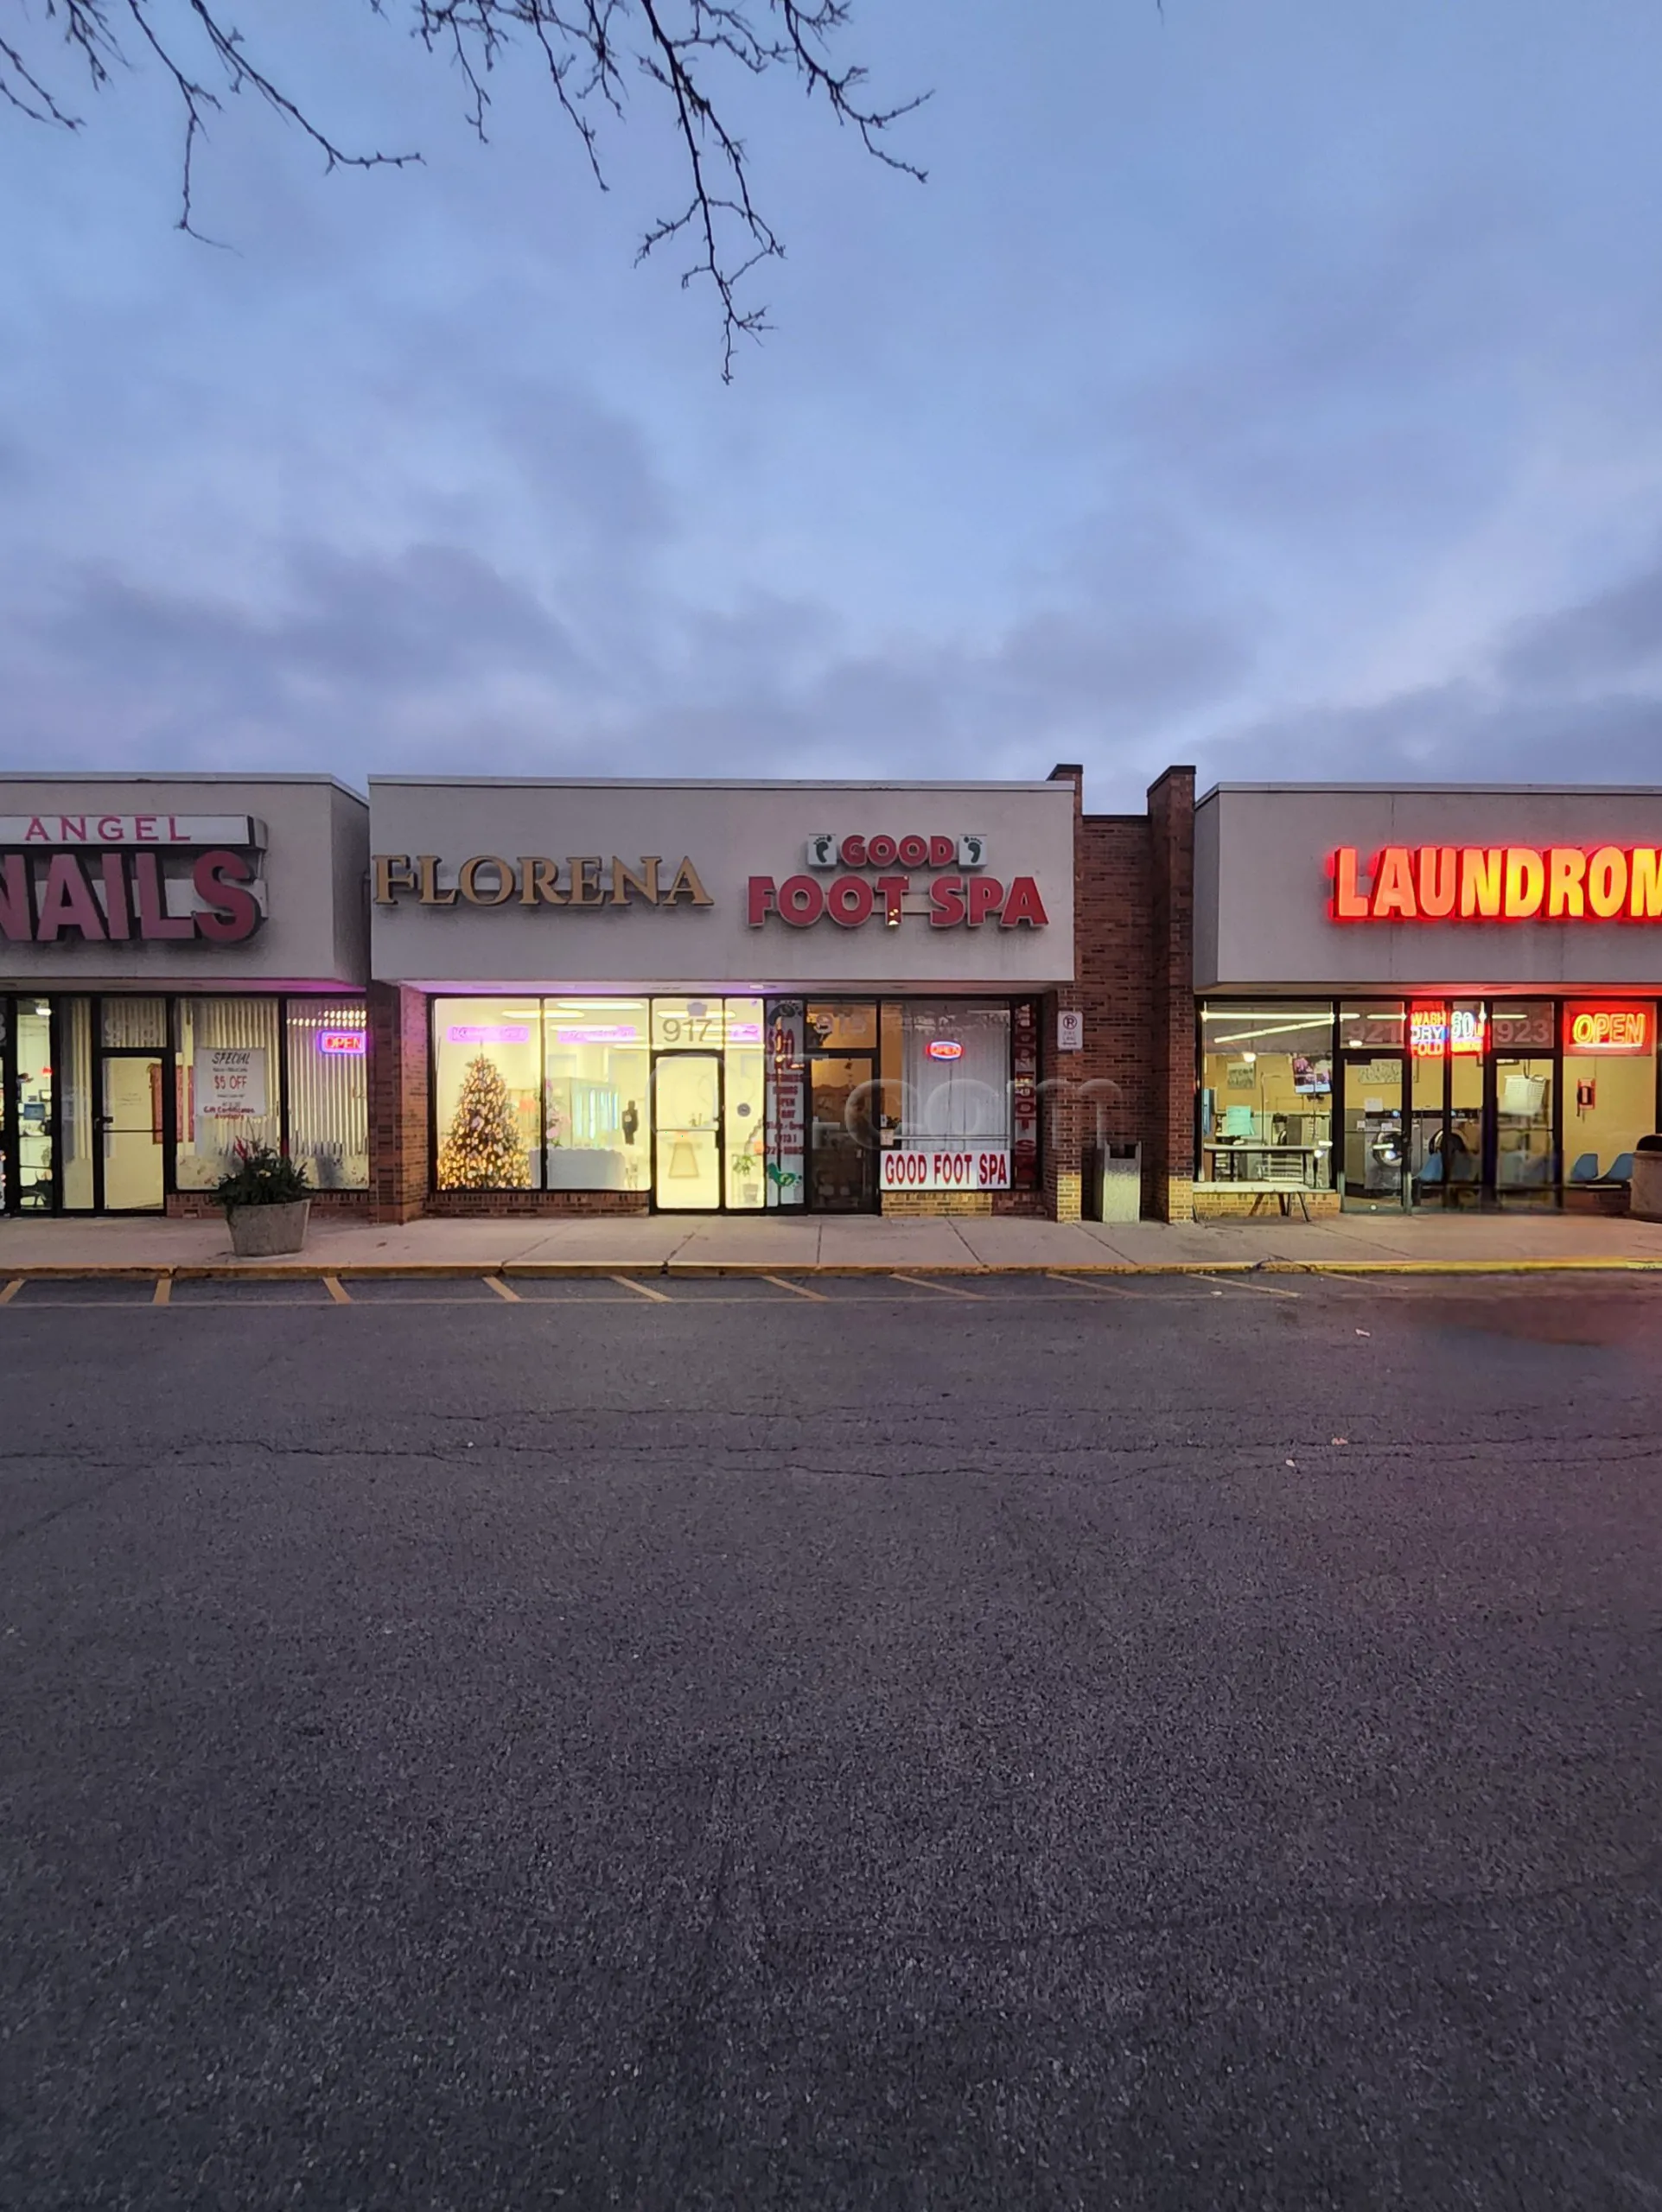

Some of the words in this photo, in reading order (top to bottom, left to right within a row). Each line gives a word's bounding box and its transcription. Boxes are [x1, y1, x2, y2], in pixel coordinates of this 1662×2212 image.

[25, 816, 191, 842] ANGEL
[840, 834, 955, 867] GOOD
[373, 855, 715, 906] FLORENA
[748, 874, 910, 927] FOOT
[929, 875, 1050, 927] SPA
[663, 1019, 712, 1042] 917
[1411, 1010, 1446, 1027] WASH
[1572, 1013, 1646, 1045] OPEN
[326, 1035, 361, 1050] OPEN
[1346, 1020, 1398, 1043] 921
[1496, 1020, 1550, 1043] 923
[213, 1075, 226, 1090] $5
[229, 1075, 248, 1090] OFF
[884, 1153, 927, 1185] GOOD
[933, 1153, 973, 1185] FOOT
[978, 1153, 1008, 1185] SPA
